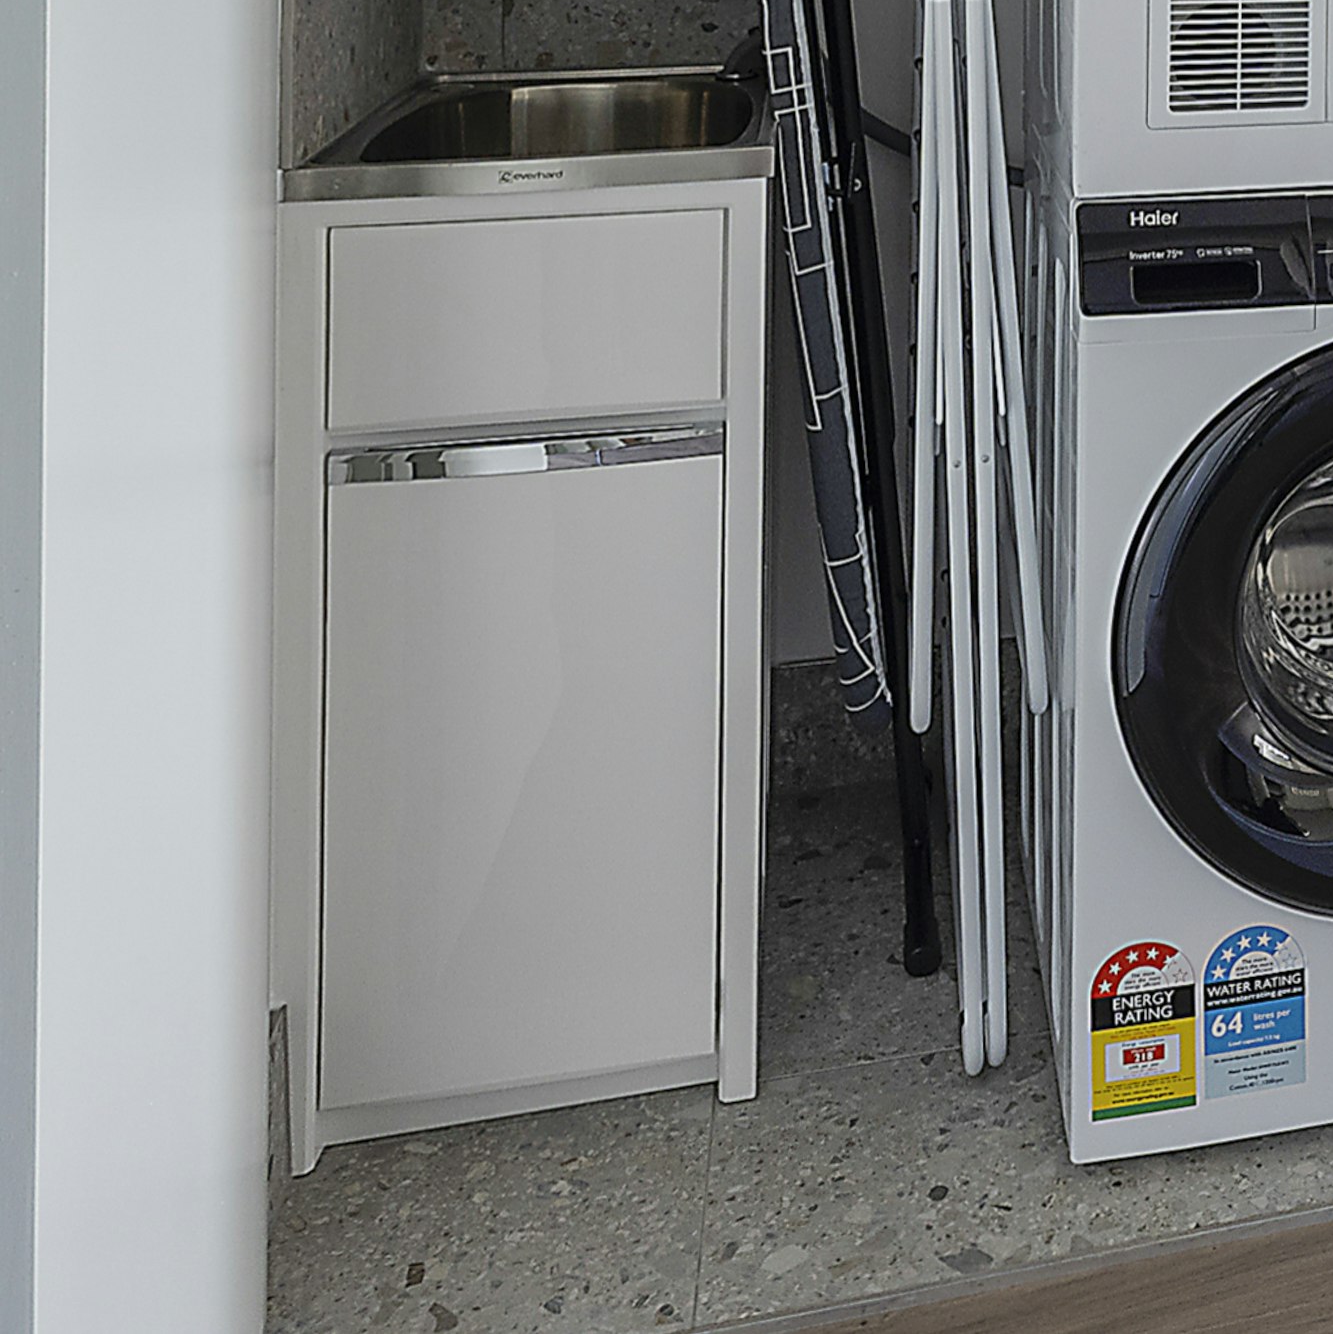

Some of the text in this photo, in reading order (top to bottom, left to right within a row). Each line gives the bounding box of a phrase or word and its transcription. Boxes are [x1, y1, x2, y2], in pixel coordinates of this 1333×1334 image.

[1130, 209, 1179, 226] Haier
[1129, 250, 1165, 261] Inverter
[1207, 972, 1302, 998] WATER RATING
[1112, 989, 1175, 1011] ENERGY
[1114, 1004, 1173, 1025] RATING
[1253, 1009, 1291, 1021] litres per
[1211, 1011, 1243, 1037] 64
[1253, 1020, 1275, 1030] wash
[1134, 1051, 1154, 1063] 218
